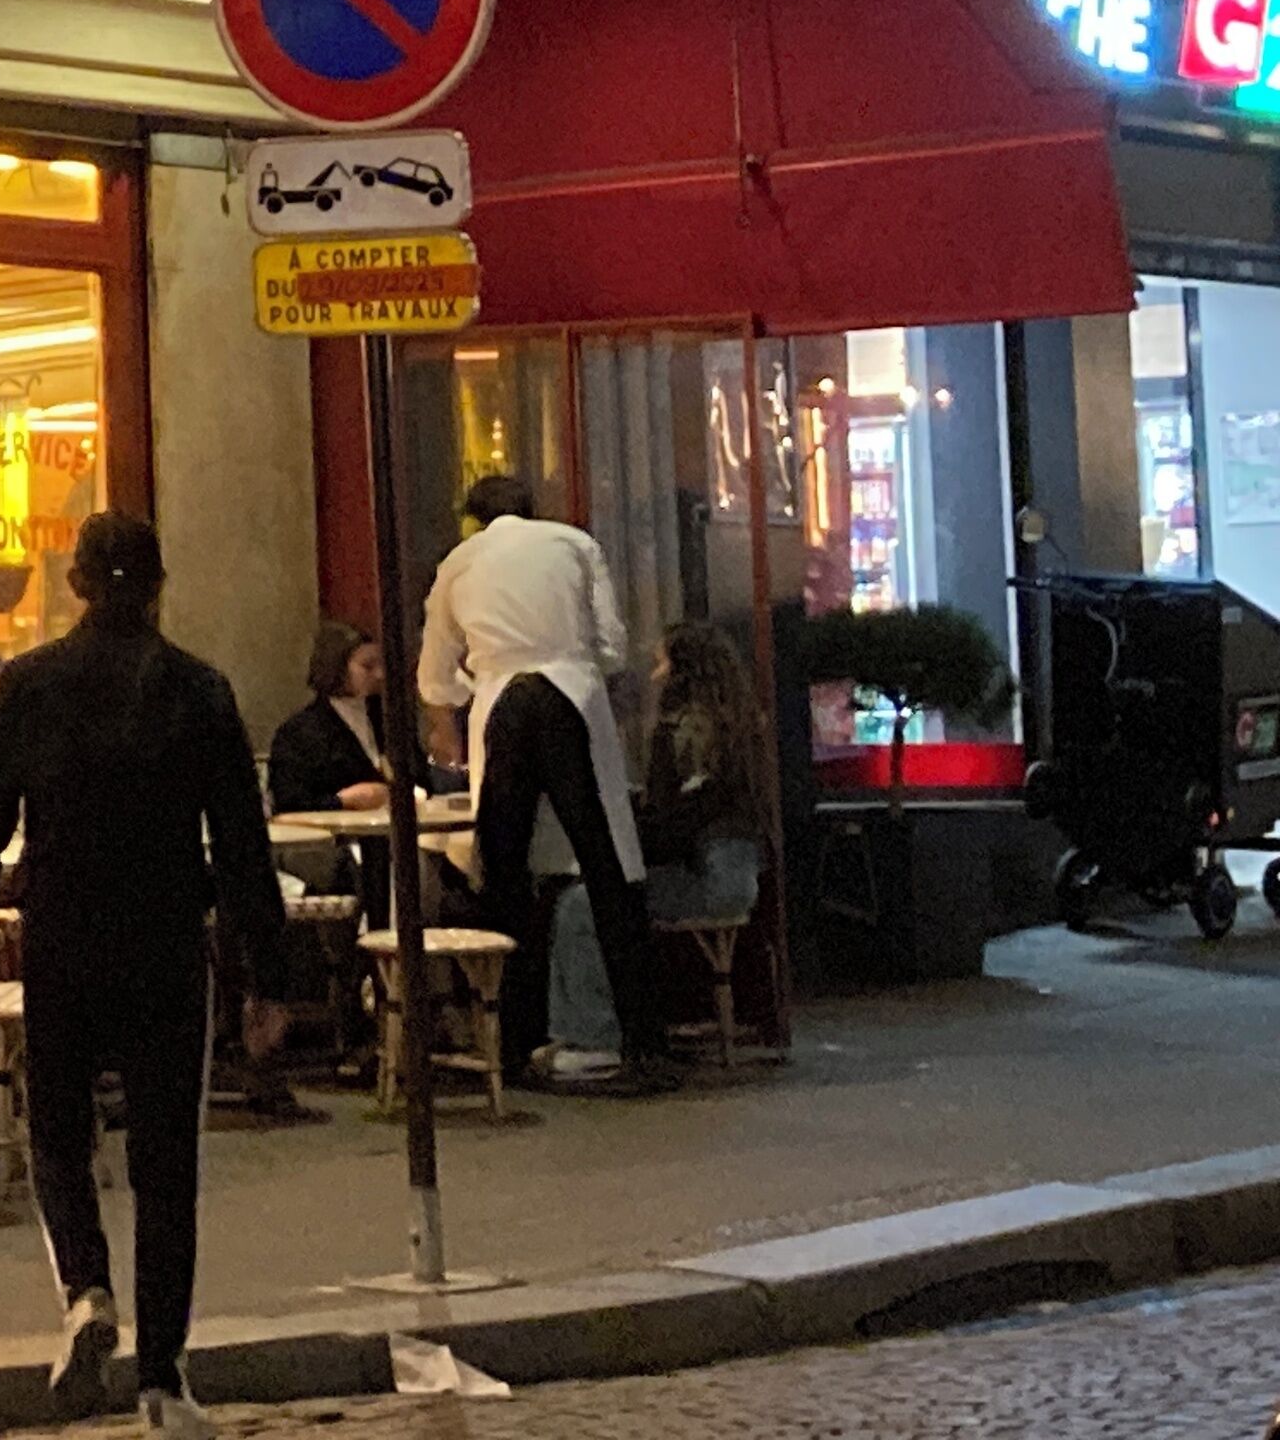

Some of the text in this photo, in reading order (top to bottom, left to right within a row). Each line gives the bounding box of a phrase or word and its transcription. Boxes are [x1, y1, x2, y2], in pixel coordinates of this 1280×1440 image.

[316, 246, 430, 269] COMPTER
[270, 297, 458, 323] POUR TRAVAUX
